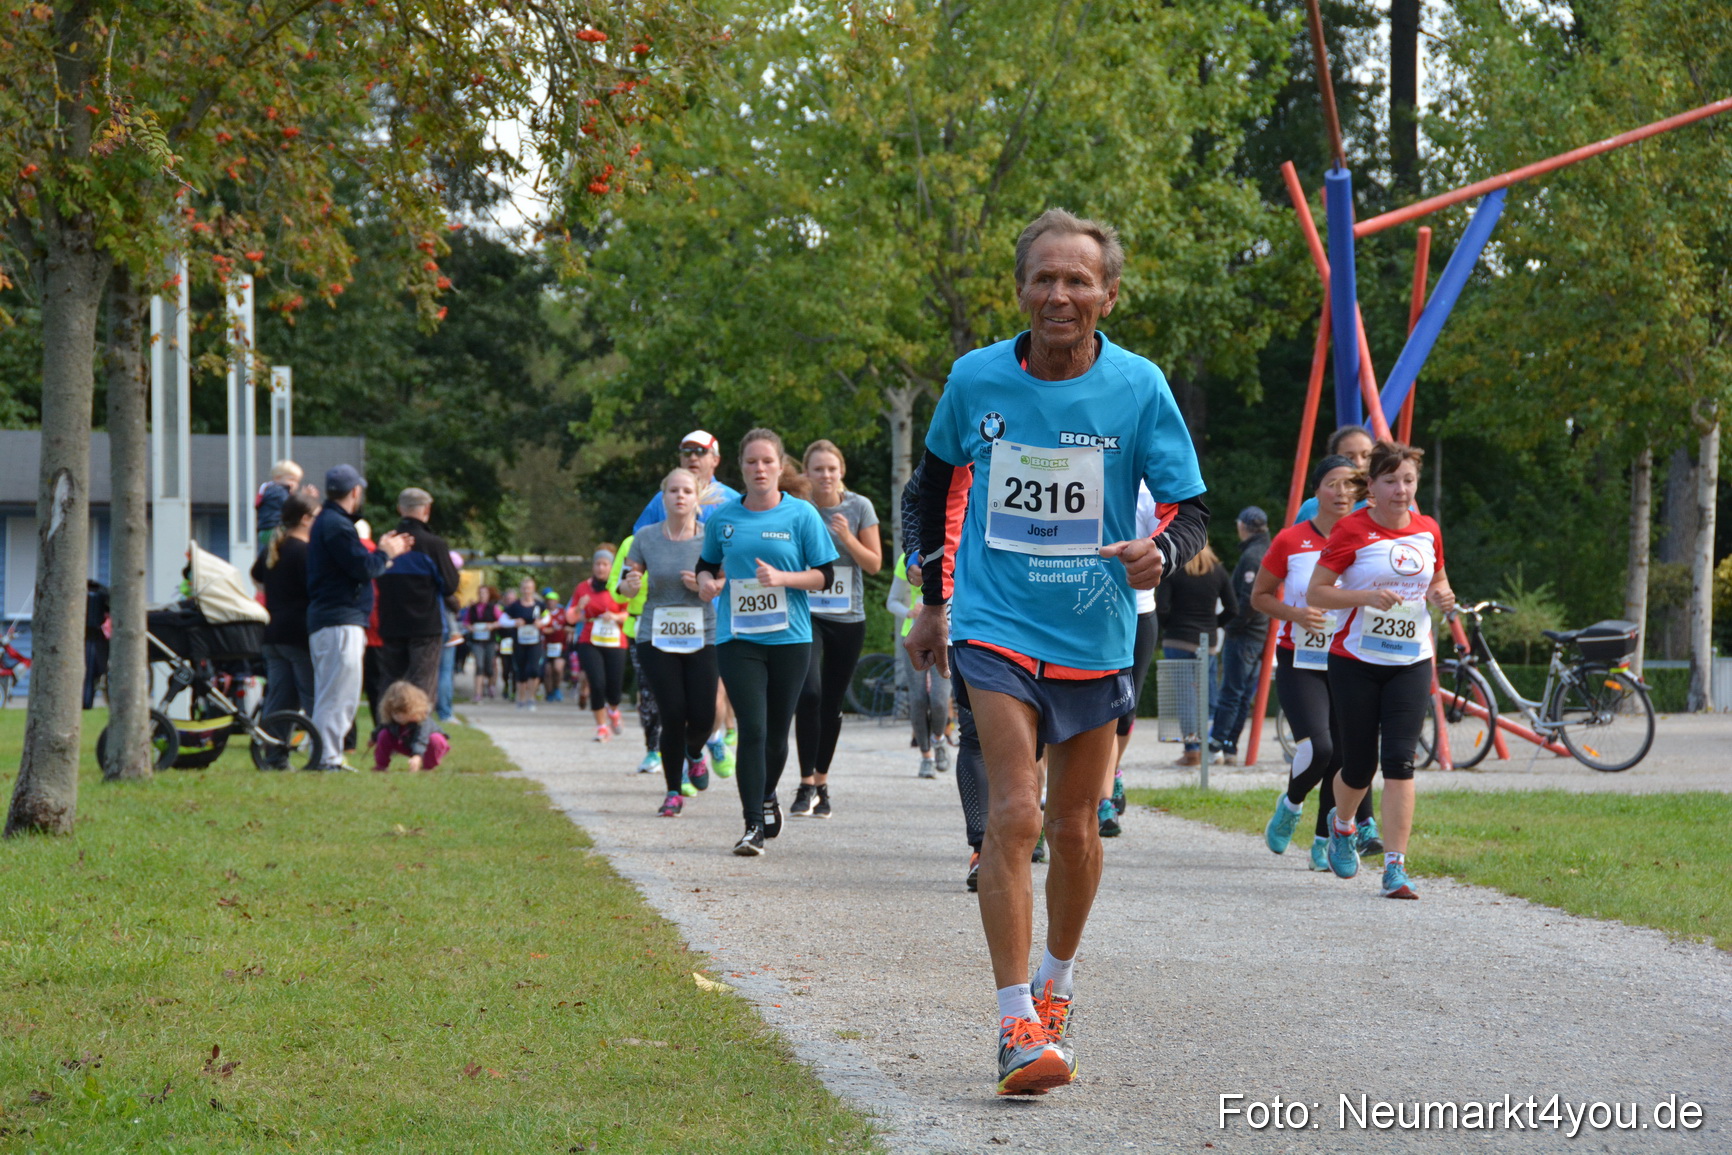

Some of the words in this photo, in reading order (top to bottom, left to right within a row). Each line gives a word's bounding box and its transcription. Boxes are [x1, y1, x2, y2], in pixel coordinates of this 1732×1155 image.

[1060, 432, 1120, 449] BOCK
[1031, 457, 1069, 468] BOCK
[1004, 477, 1085, 513] 2316
[1027, 524, 1058, 537] Josef
[1028, 571, 1088, 584] Stadtlauf
[739, 593, 777, 612] 2930
[660, 622, 696, 635] 2036
[1372, 616, 1415, 638] 2338
[1381, 641, 1403, 650] Renate
